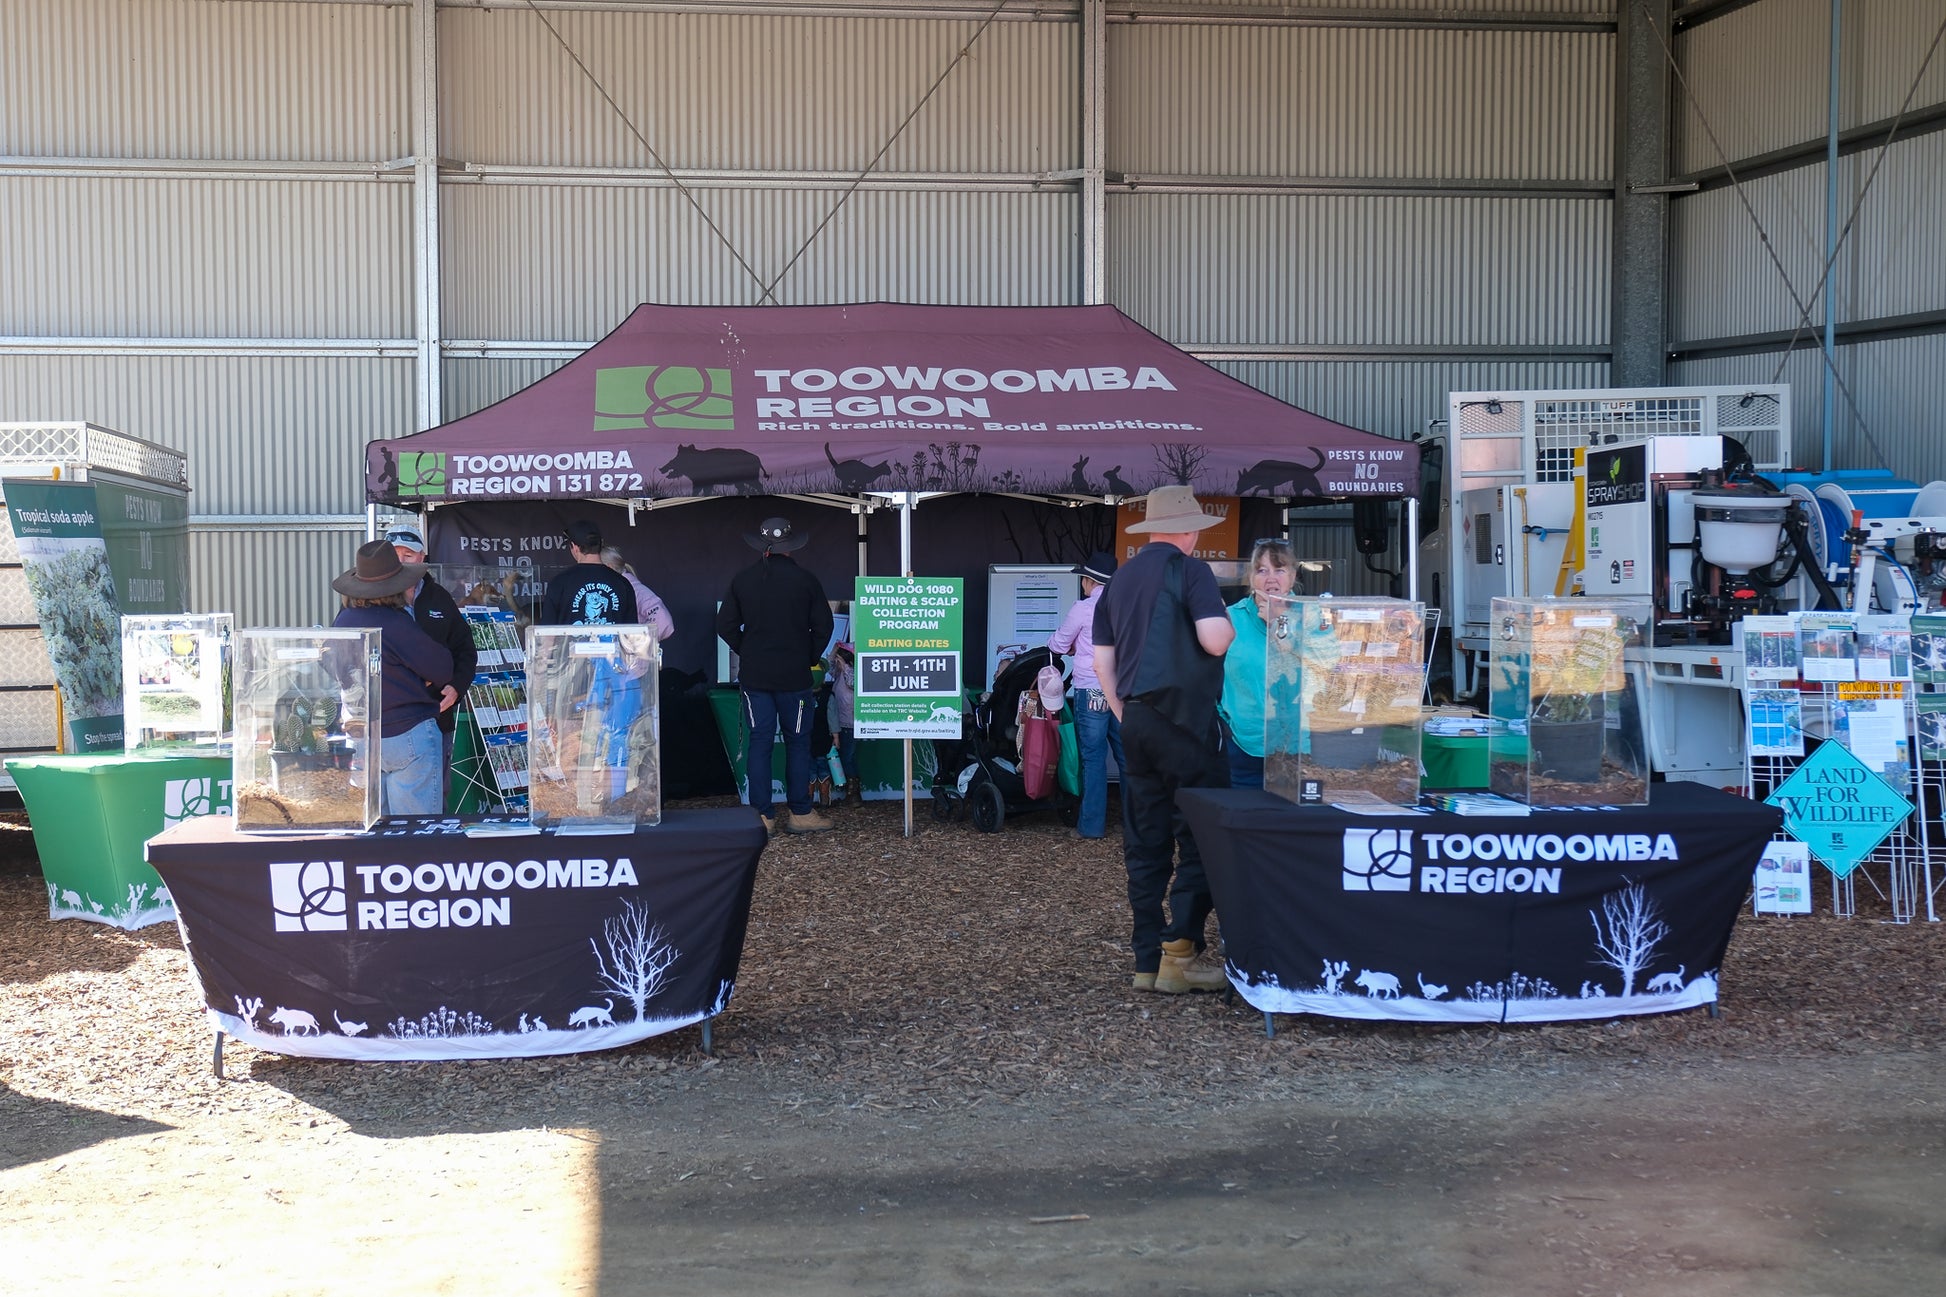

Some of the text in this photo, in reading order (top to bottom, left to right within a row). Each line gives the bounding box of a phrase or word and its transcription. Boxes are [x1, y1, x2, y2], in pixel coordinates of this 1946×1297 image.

[755, 366, 1178, 393] TOOWOOMBA
[756, 396, 991, 419] REGION
[1602, 402, 1633, 410] TUFF
[759, 420, 1203, 432] Rich traditions. Bold ambitions.
[453, 450, 634, 474] TOOWOOMBA
[1329, 450, 1404, 461] PESTS KNOW
[1354, 463, 1379, 480] NO
[452, 474, 643, 495] REGION 131 872
[1329, 482, 1404, 492] BOUNDARIES
[125, 494, 145, 521] PESTS
[16, 508, 95, 526] Tropical soda apple
[140, 531, 152, 570] NO
[460, 536, 513, 552] PESTS
[499, 556, 533, 578] NO
[596, 583, 613, 593] ONLY
[865, 584, 954, 594] WILD DOG 1080
[860, 596, 959, 606] BAITING & SCALP
[872, 609, 946, 618] COLLECTION
[879, 620, 939, 629] PROGRAM
[868, 639, 949, 648] BAITING DATES
[871, 659, 900, 672] 8TH
[912, 659, 946, 672] 11TH
[889, 676, 929, 690] JUNE
[1805, 768, 1867, 784] LAND
[1815, 787, 1861, 803] FOR
[1775, 796, 1896, 823] WILDLIFE
[1421, 833, 1678, 862] TOOWOOMBA
[355, 858, 638, 894] TOOWOOMBA
[1420, 867, 1562, 894] REGION
[357, 897, 511, 930] REGION
